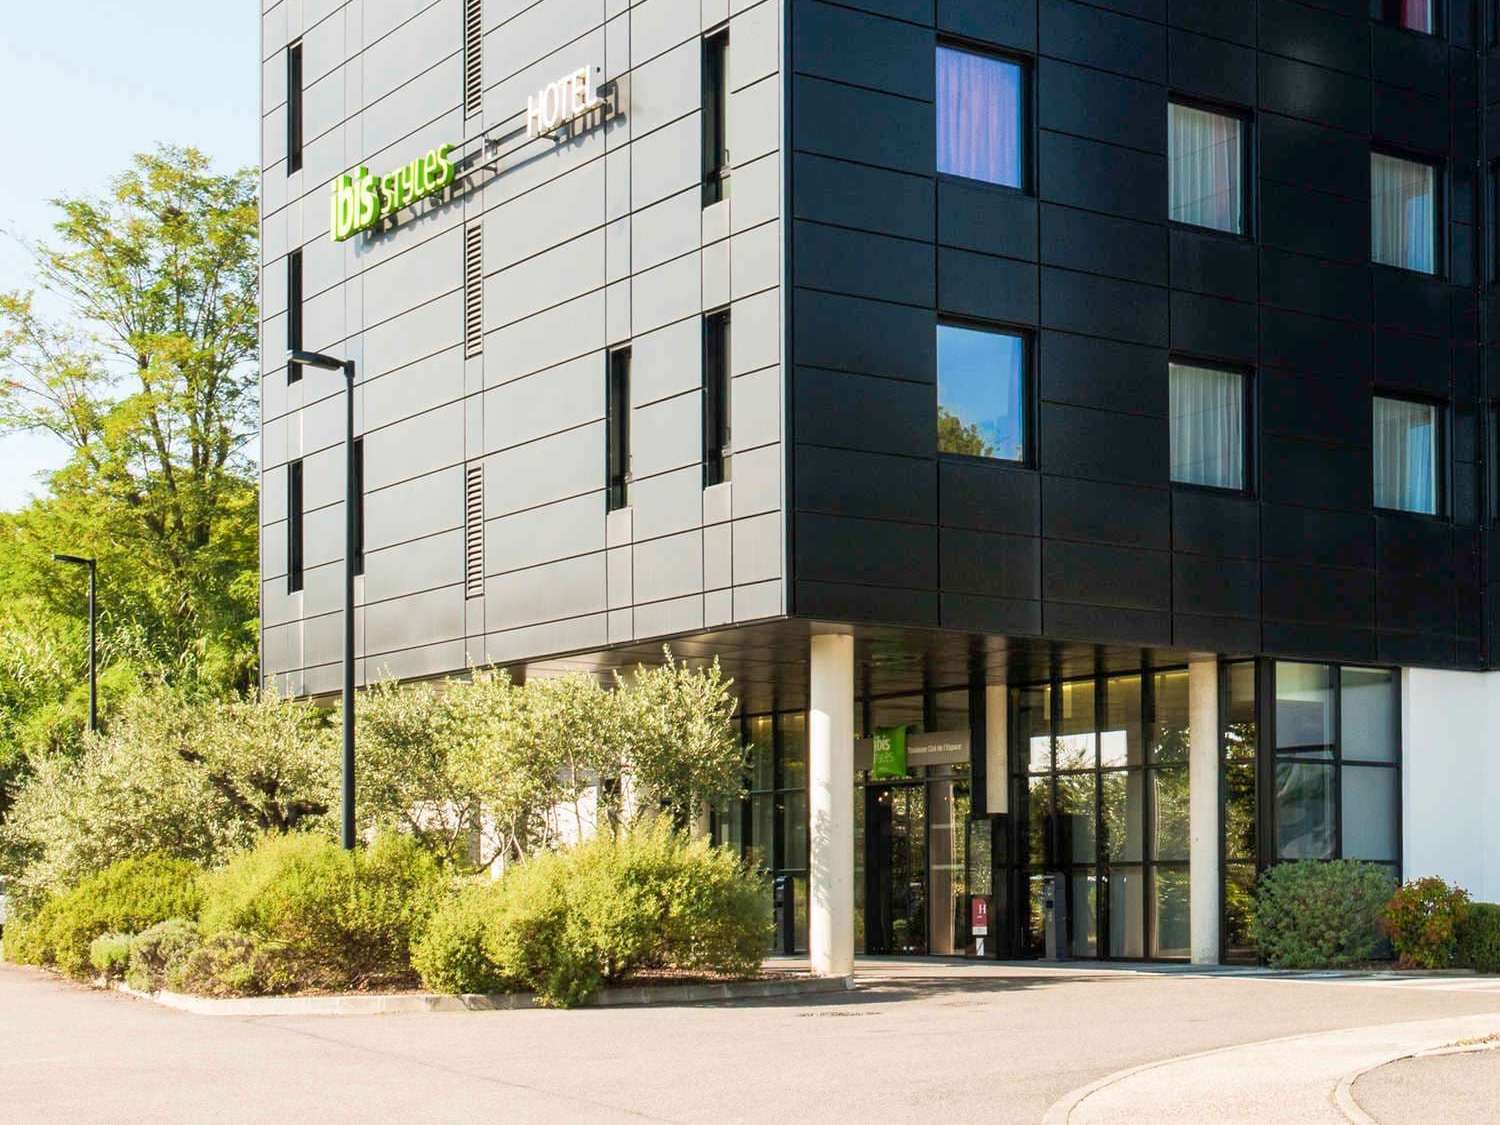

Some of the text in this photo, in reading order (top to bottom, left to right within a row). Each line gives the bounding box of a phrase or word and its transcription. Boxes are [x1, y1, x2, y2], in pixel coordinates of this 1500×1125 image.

[330, 165, 380, 242] ibis
[526, 65, 601, 138] HOTEL
[978, 903, 987, 915] H
